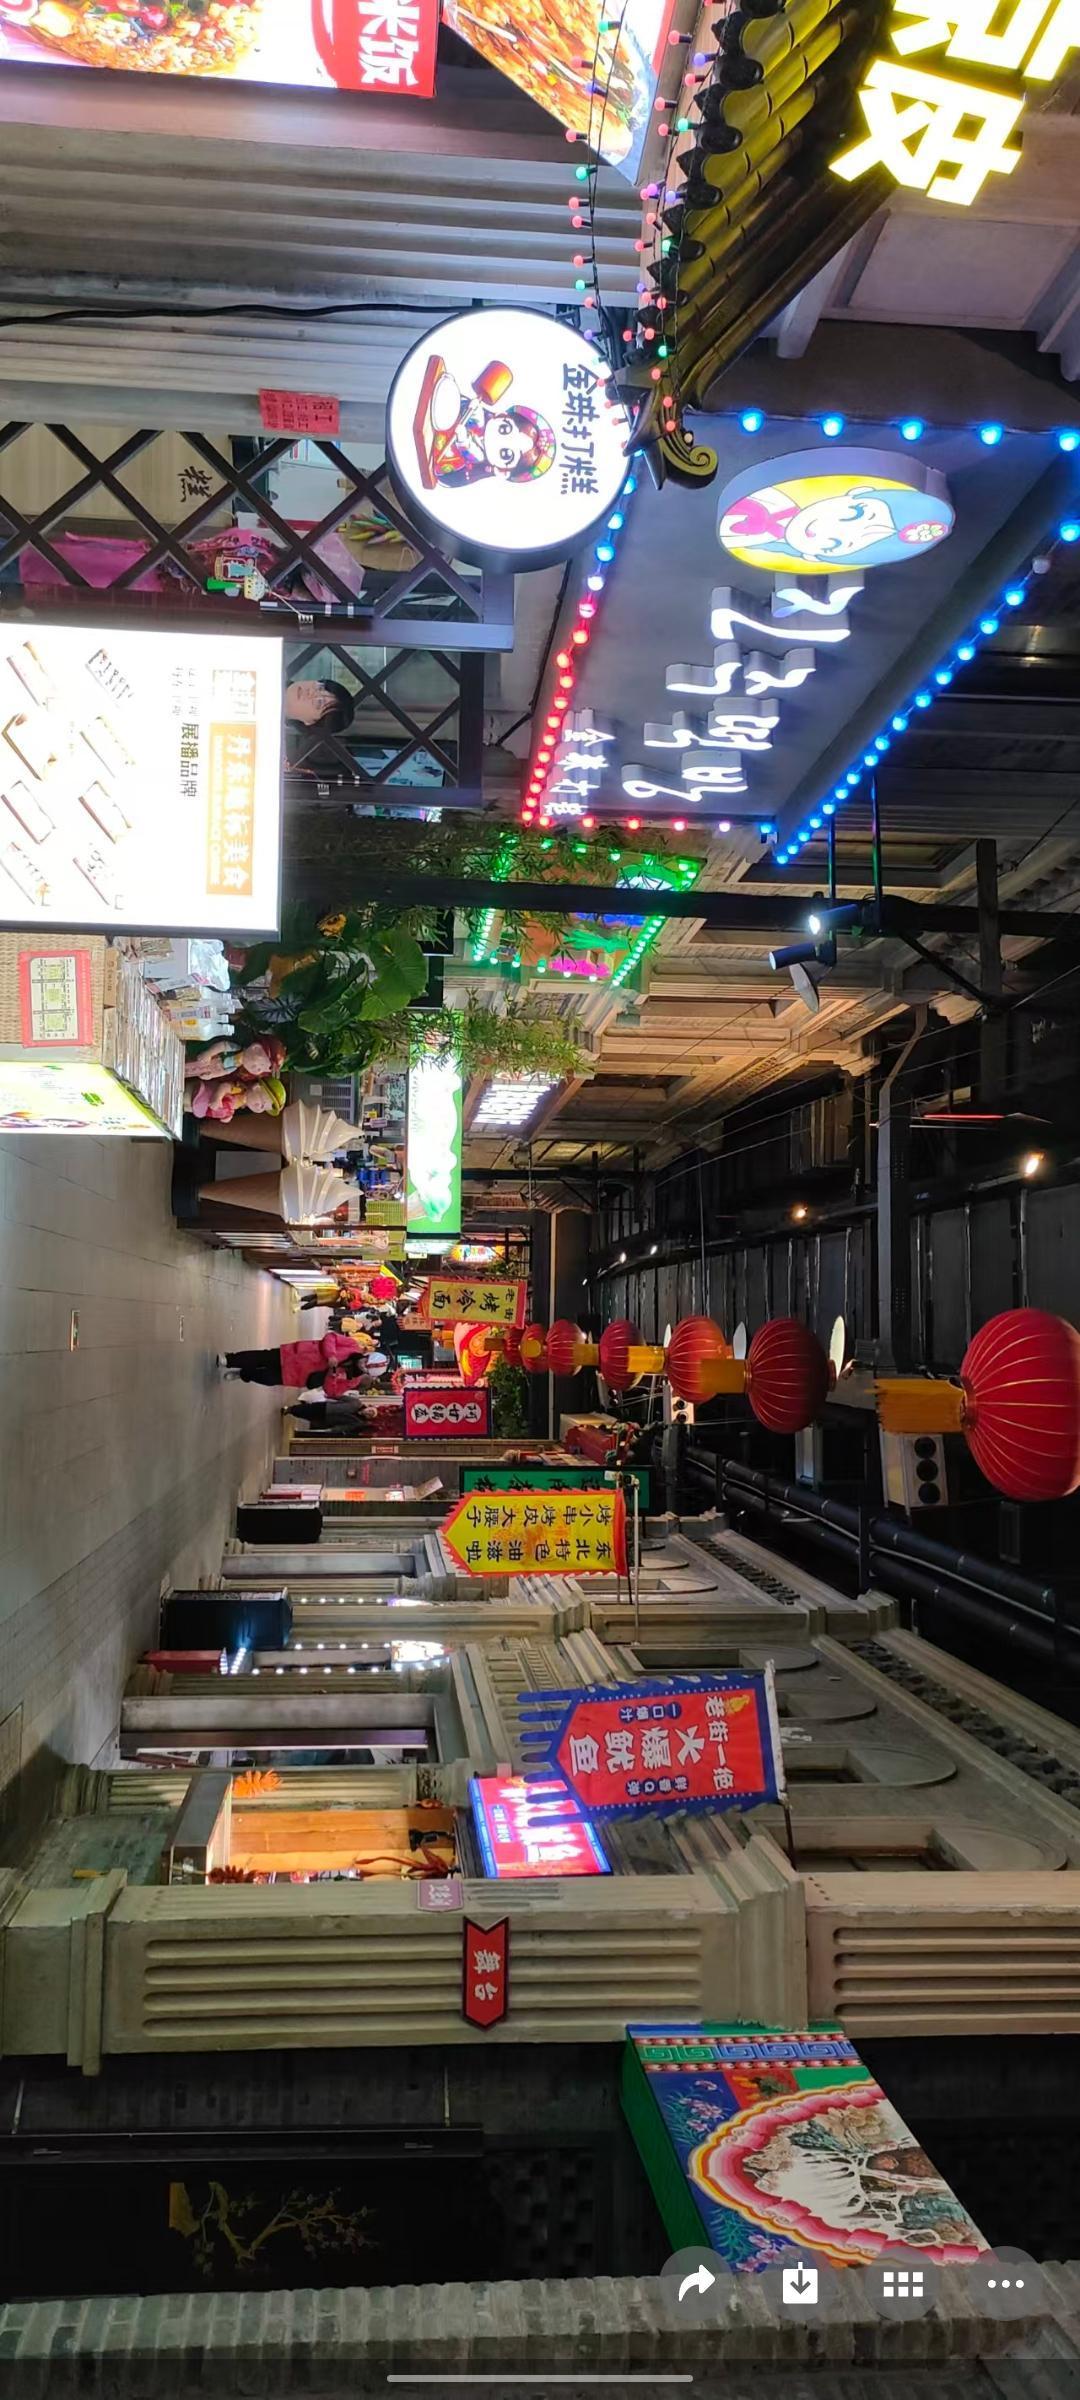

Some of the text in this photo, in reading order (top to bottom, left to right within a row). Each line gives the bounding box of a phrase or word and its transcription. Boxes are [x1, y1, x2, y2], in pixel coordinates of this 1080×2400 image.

[560, 363, 600, 495] 金珠打糕
[622, 587, 864, 802] 진주떡방
[179, 723, 200, 797] 展播品牌
[432, 1289, 500, 1314] 烤冷面
[505, 1288, 515, 1321] 老街
[620, 1703, 677, 1721] 一口爆汁
[569, 1725, 705, 1776] 火爆鱿鱼
[705, 1695, 734, 1790] 老街一绝
[473, 1950, 501, 2000] 舞台
